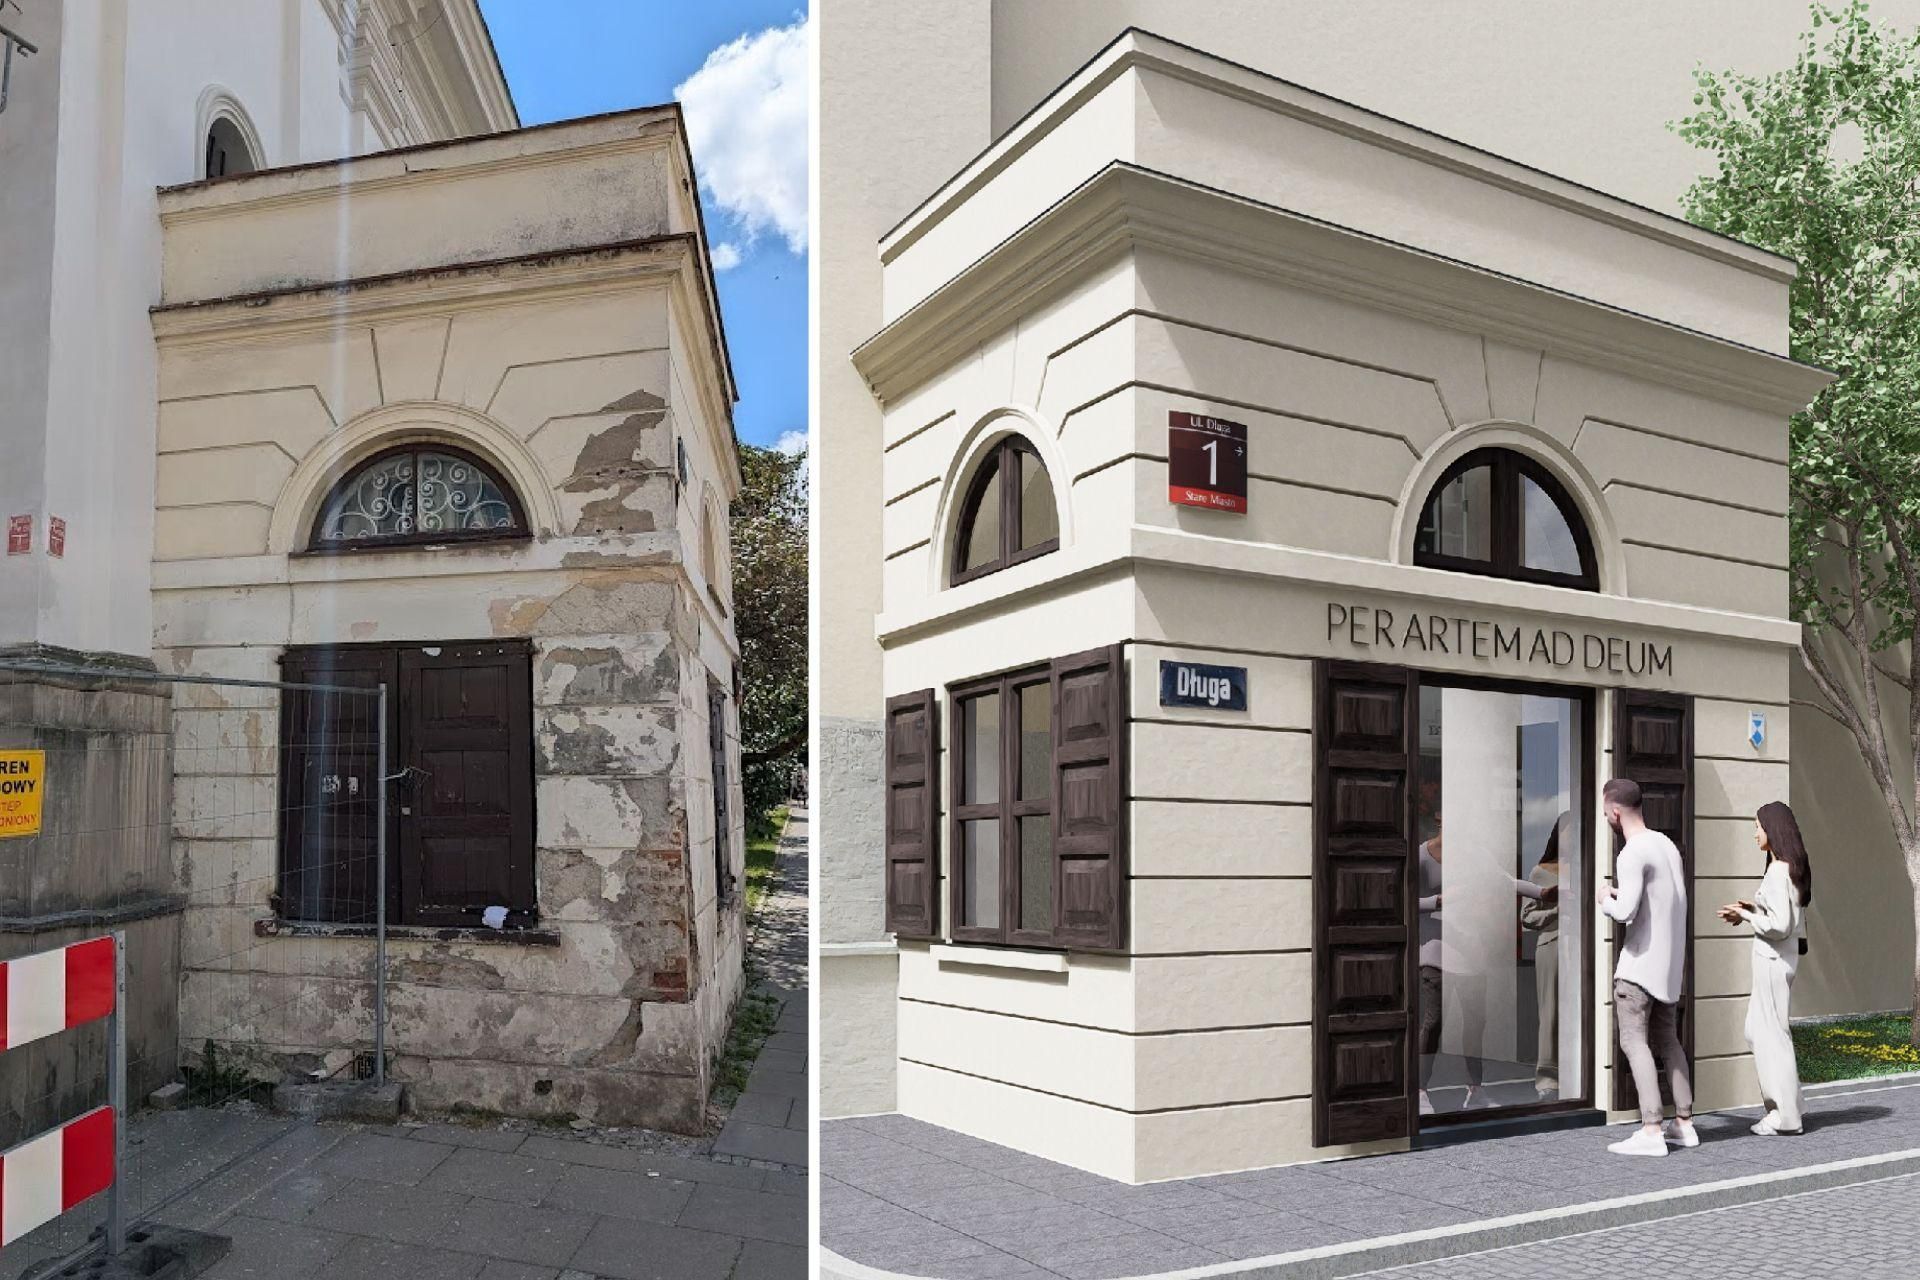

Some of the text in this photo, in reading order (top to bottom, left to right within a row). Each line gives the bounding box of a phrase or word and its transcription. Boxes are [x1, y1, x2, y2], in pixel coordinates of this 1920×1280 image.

[1201, 440, 1217, 485] 1
[1327, 602, 1674, 678] PER ARTEM AD DEUM
[1177, 667, 1231, 706] Długa
[0, 761, 30, 774] REN
[0, 780, 36, 794] OWY
